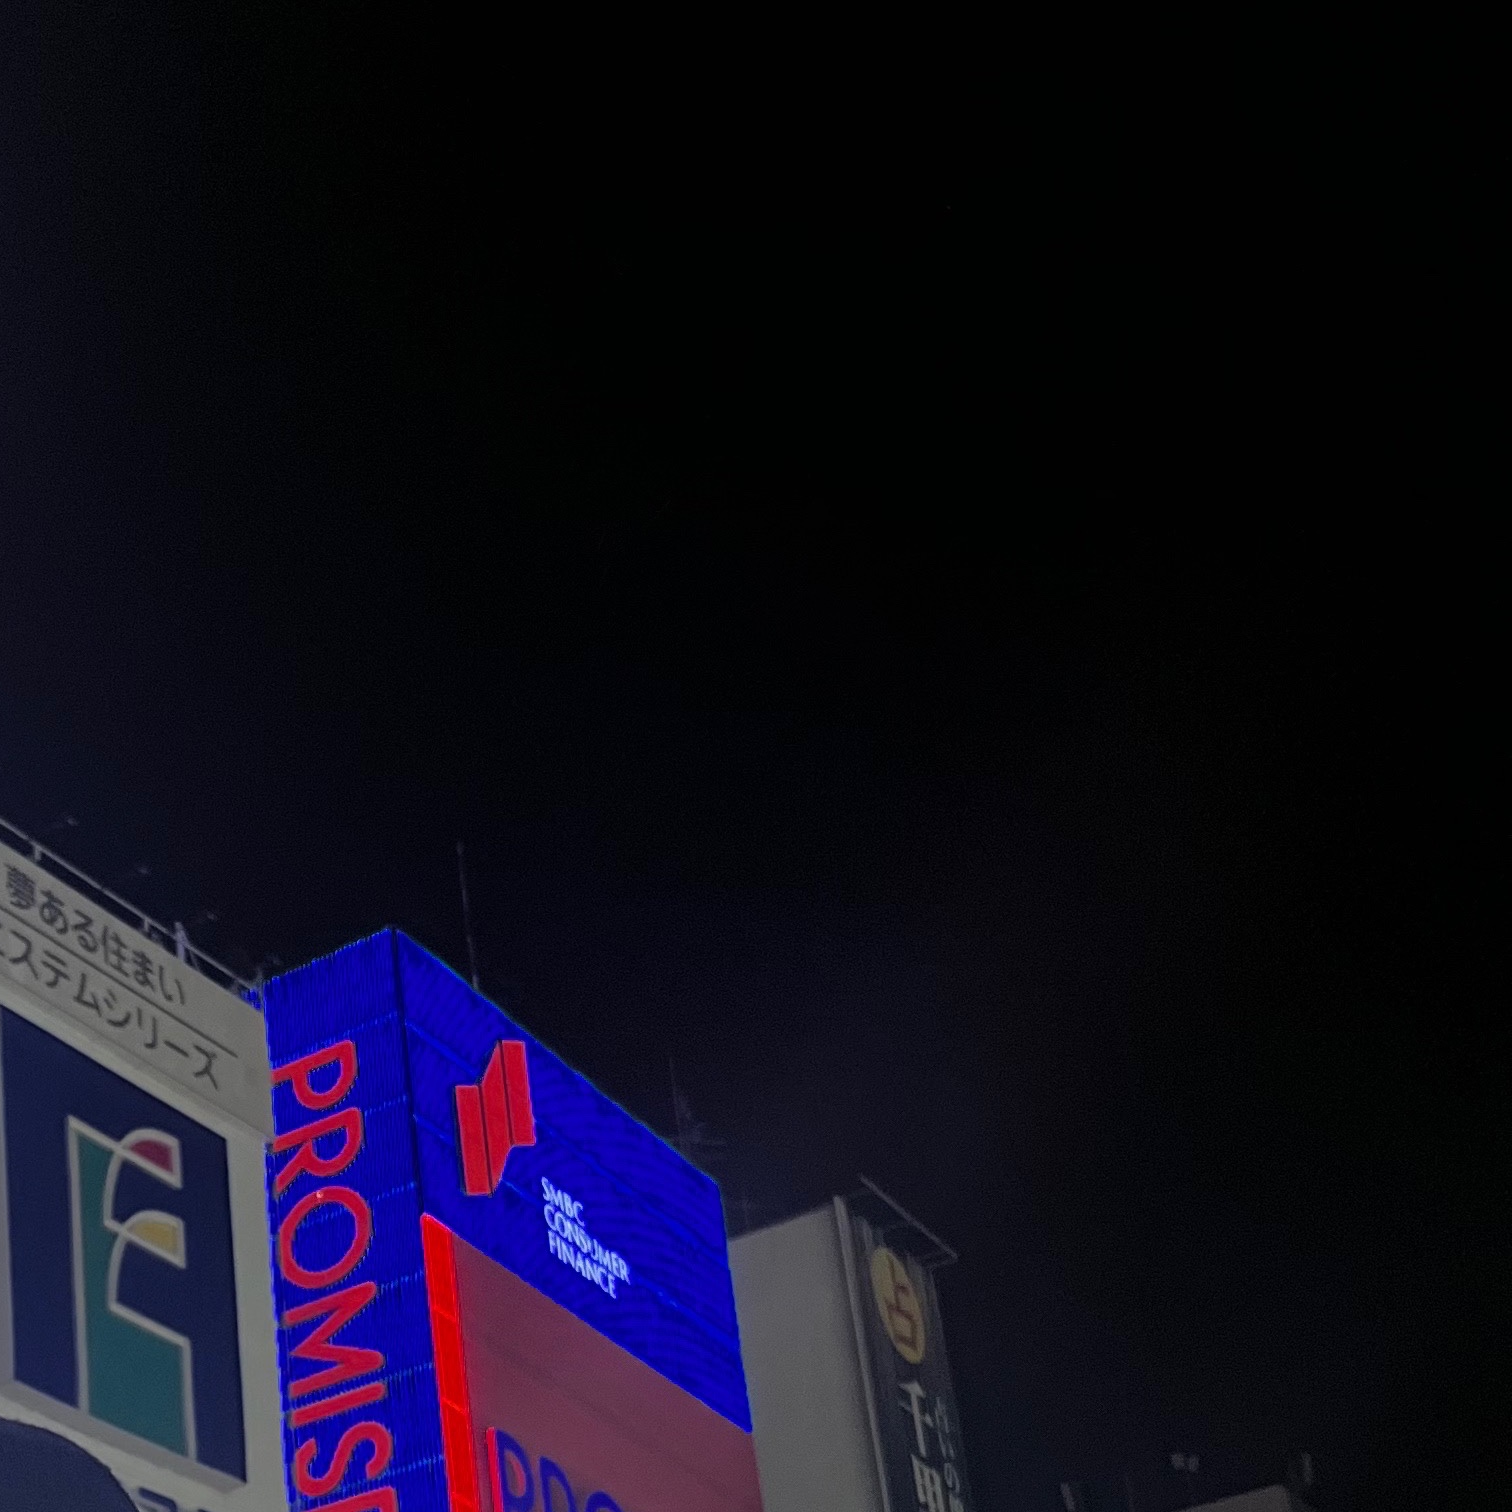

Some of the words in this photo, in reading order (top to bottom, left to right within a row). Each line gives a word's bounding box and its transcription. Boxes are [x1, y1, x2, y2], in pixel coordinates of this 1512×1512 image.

[2, 861, 186, 1006] 夢ある住まい
[541, 1176, 585, 1227] SMBC
[544, 1203, 631, 1285] CONSUMER
[548, 1230, 617, 1299] FINANCE
